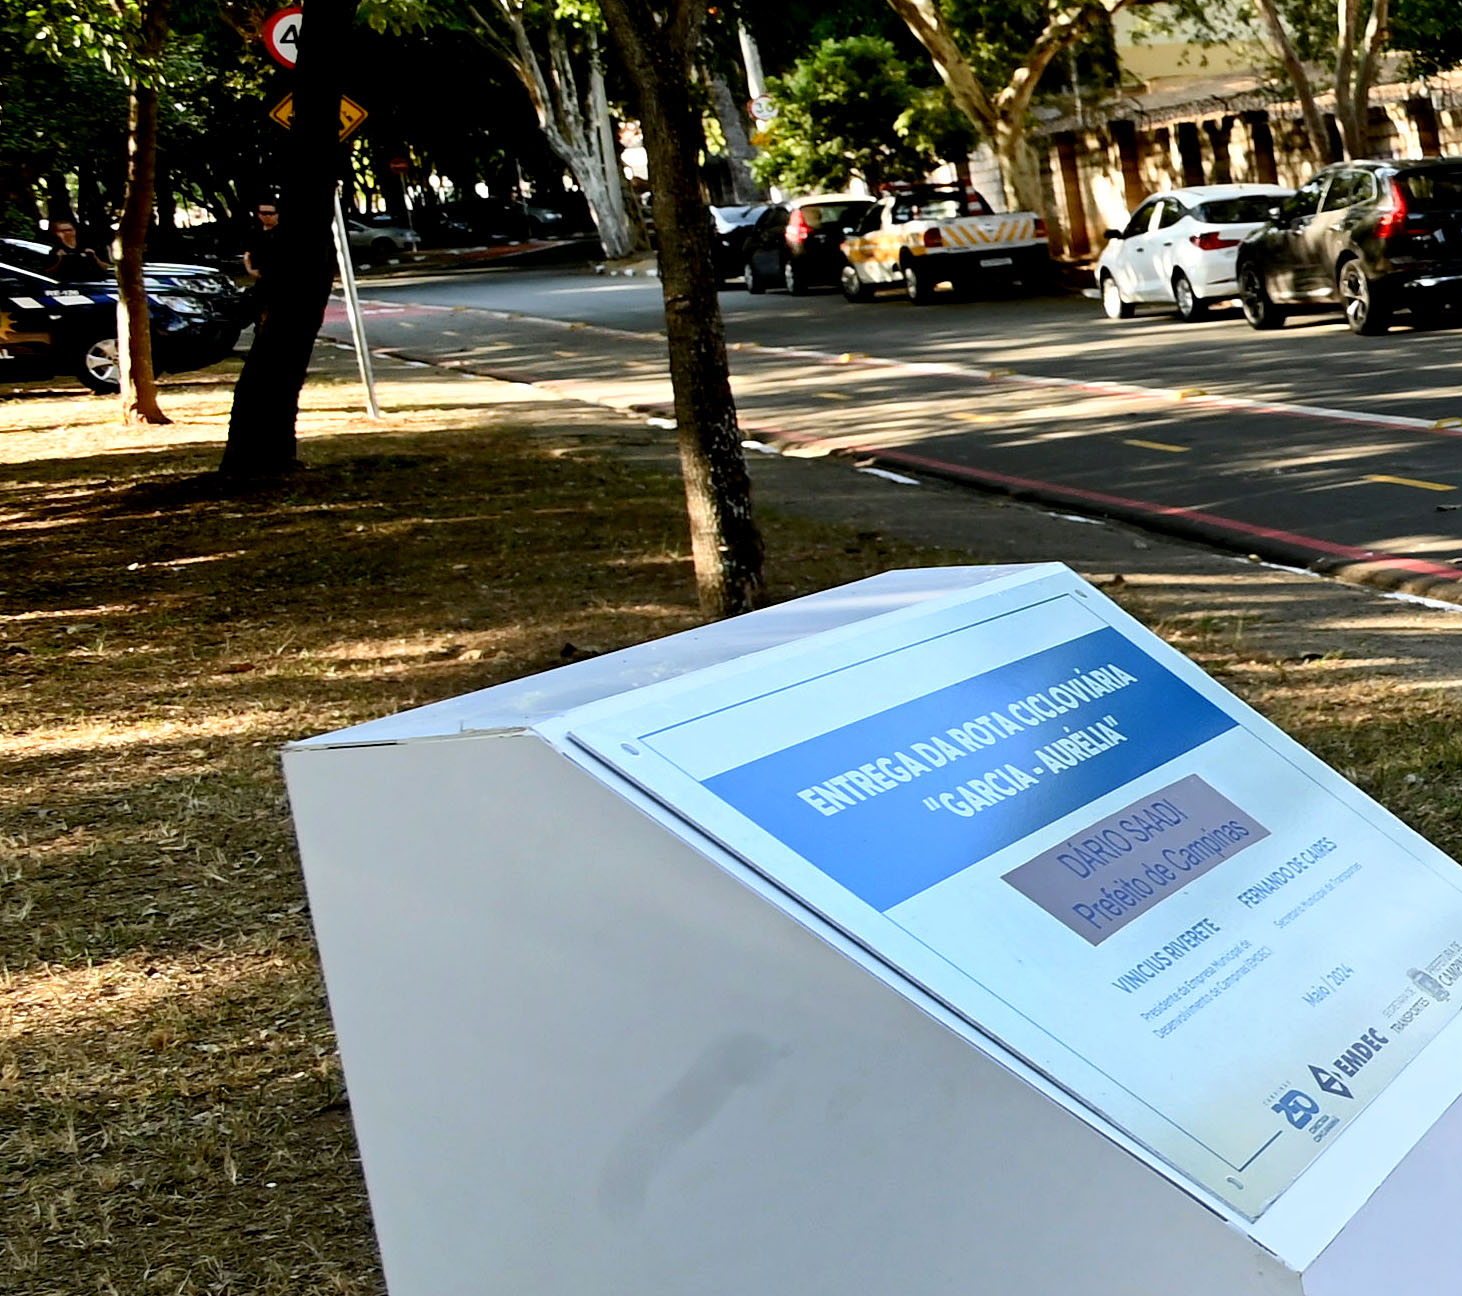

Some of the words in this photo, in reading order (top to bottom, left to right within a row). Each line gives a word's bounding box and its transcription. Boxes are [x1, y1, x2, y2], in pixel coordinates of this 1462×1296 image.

[796, 752, 932, 816] ENTREGA
[910, 735, 967, 768] DA
[946, 711, 1025, 752] ROTA
[1007, 663, 1138, 726] CICLOVIÁRIA
[1056, 829, 1132, 879] DÁRIO
[1118, 798, 1188, 842] SAADI
[1072, 878, 1154, 929] Prefeito
[1141, 862, 1176, 886] de
[1162, 820, 1250, 871] Campinas
[1236, 866, 1296, 909] FERNANDO
[1286, 856, 1308, 874] DE
[1299, 836, 1338, 864] CAIRES
[1111, 951, 1173, 994] VINICIUS
[1162, 917, 1221, 960] RIVERETE
[1301, 985, 1330, 1008] Maio
[1326, 962, 1355, 986] 2024
[1140, 991, 1182, 1022] Presidente
[1184, 965, 1217, 990] Empresa
[1389, 996, 1431, 1034] TRANSPORTES
[1332, 1026, 1389, 1078] EMDEC
[1270, 1089, 1320, 1130] 250
